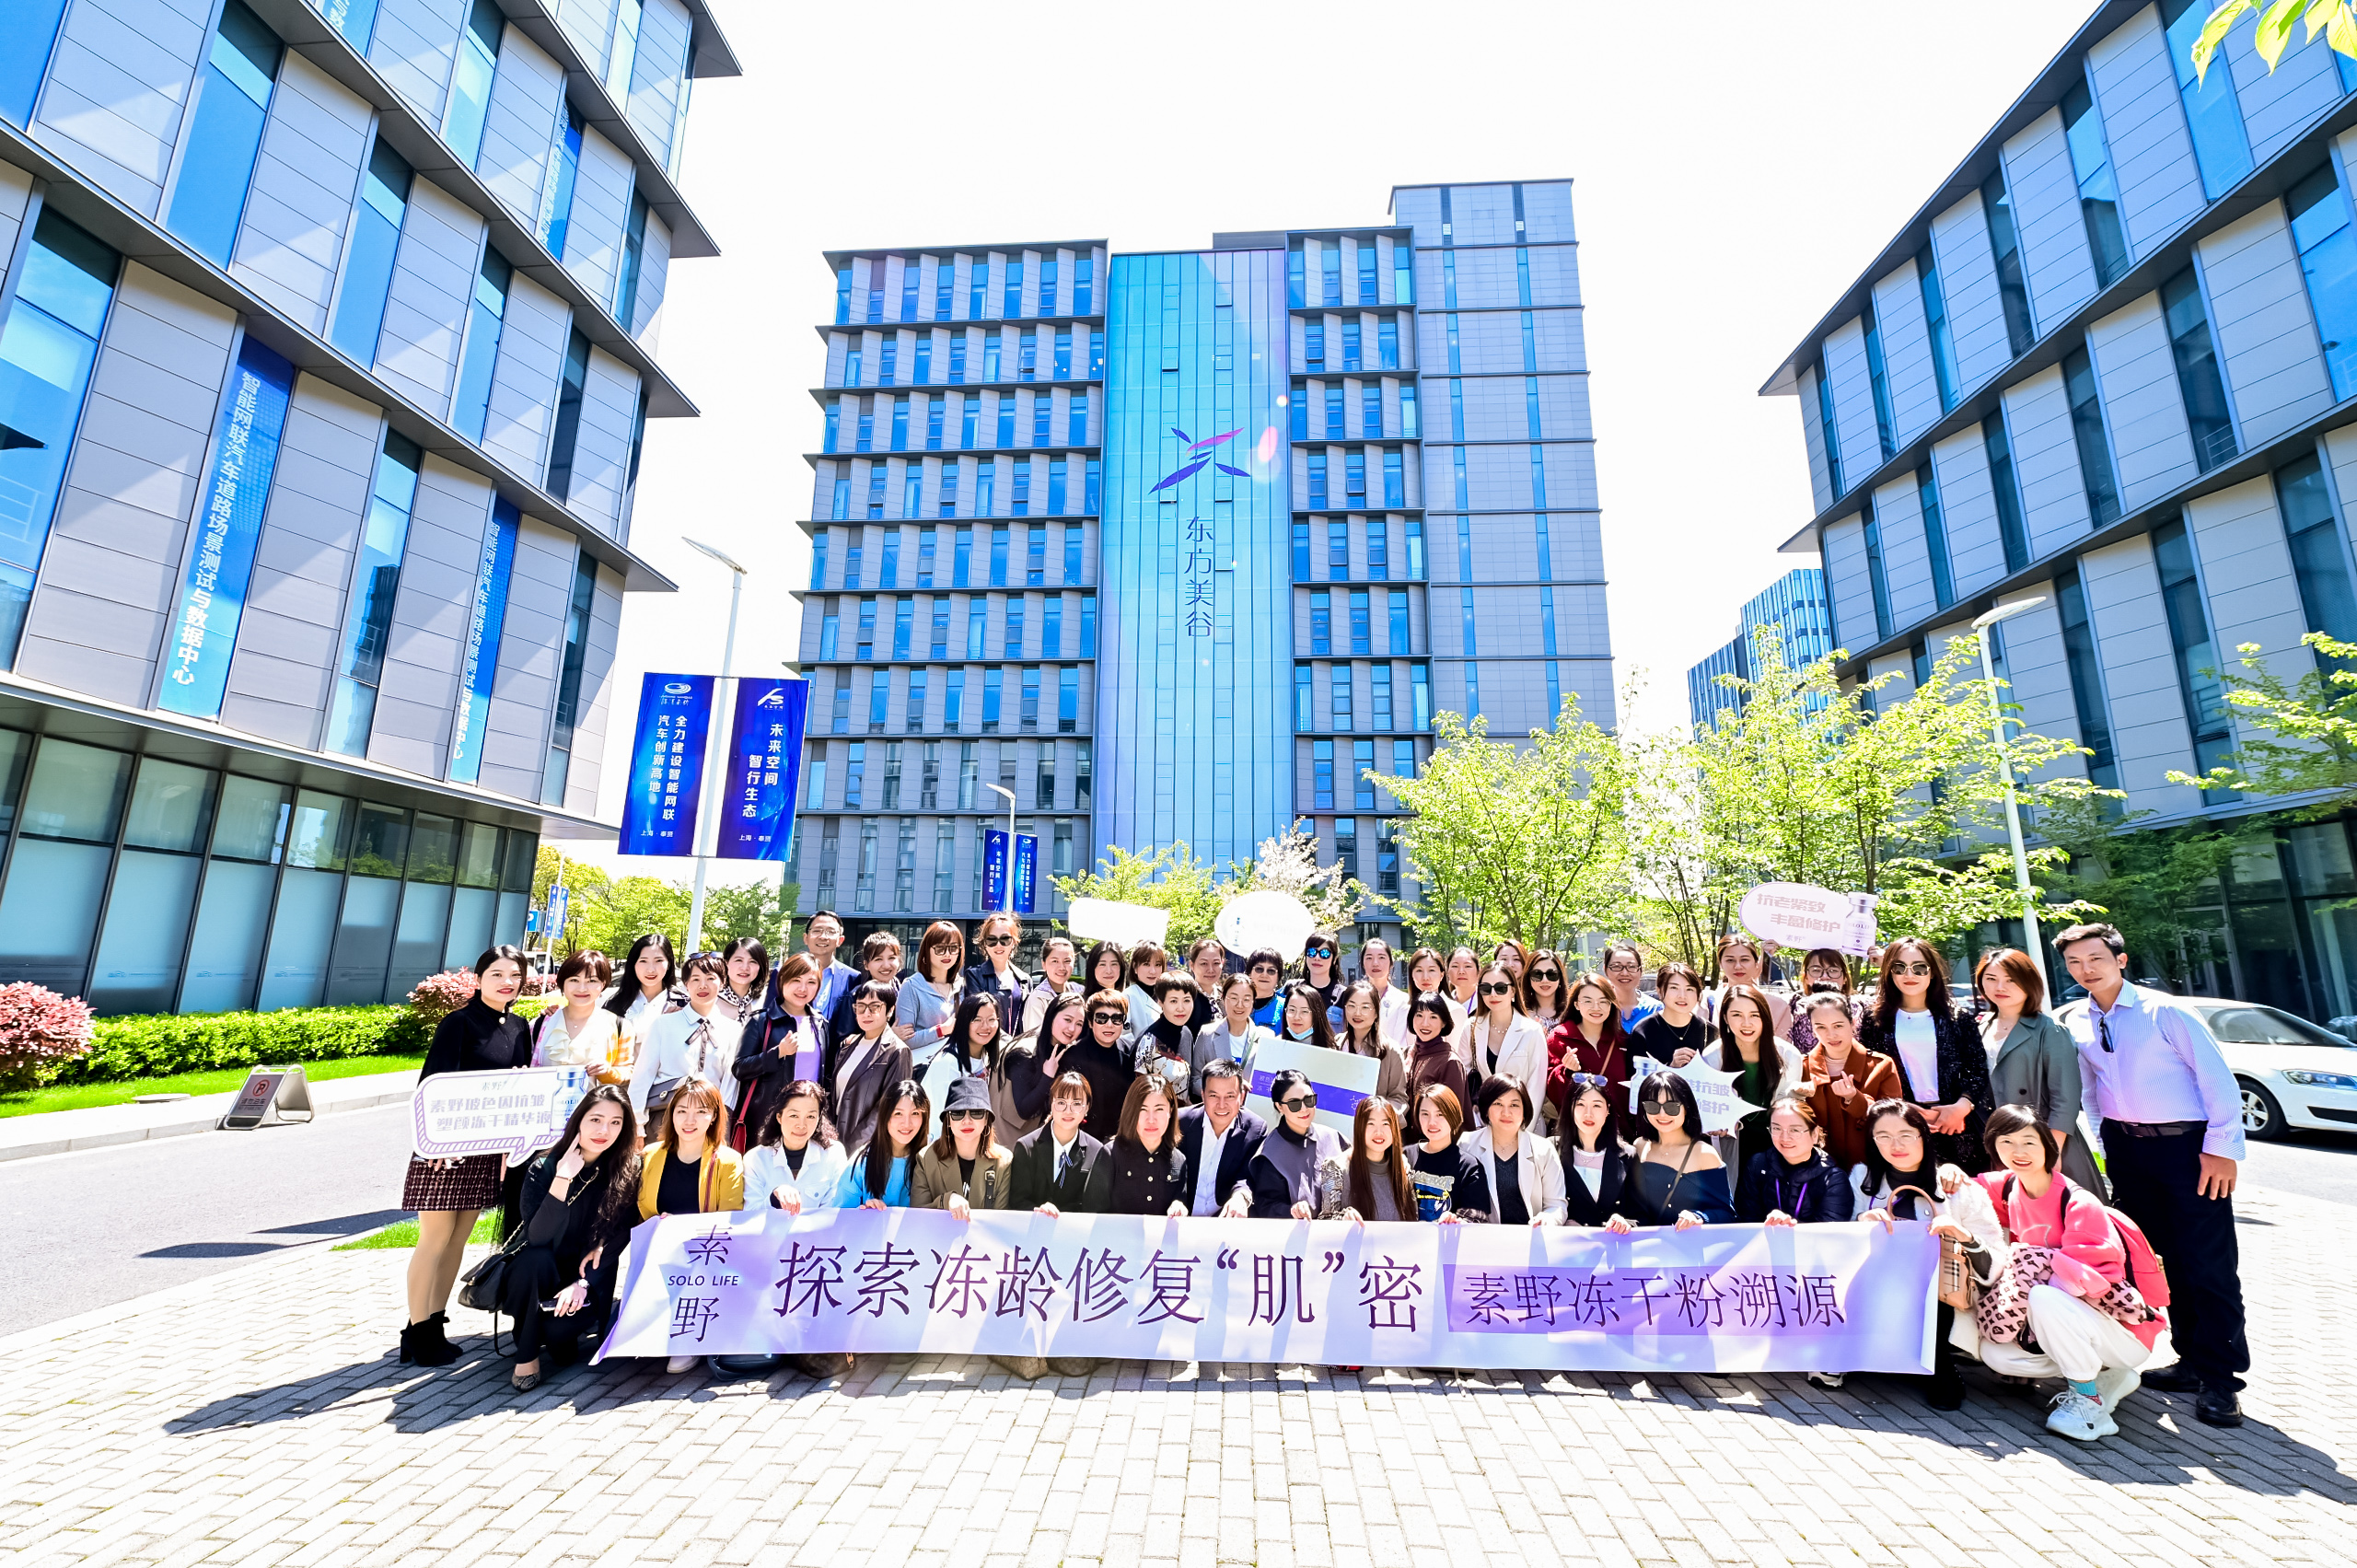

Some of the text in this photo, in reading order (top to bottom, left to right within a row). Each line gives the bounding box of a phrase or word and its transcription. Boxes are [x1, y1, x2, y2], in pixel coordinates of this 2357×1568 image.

[171, 371, 261, 686] 智能网联汽车道路场景测试与数据中心
[1184, 516, 1213, 637] 东方美谷
[647, 714, 670, 793] 汽车创新高地
[662, 714, 688, 820] 全力建设智能网联
[763, 723, 784, 786] 未来空间
[742, 754, 762, 819] 智行生态
[1757, 893, 1827, 914] 抗老紧致
[1770, 912, 1840, 933] 丰盈修护
[430, 1094, 546, 1113] 素野玻色因抗皱
[435, 1111, 552, 1132] 塑颜冻干精华液
[686, 1224, 733, 1267] 素
[667, 1274, 739, 1287] SOLO LIFE
[1462, 1272, 1845, 1328] 素野冻干粉溯源
[669, 1296, 720, 1342] 野
